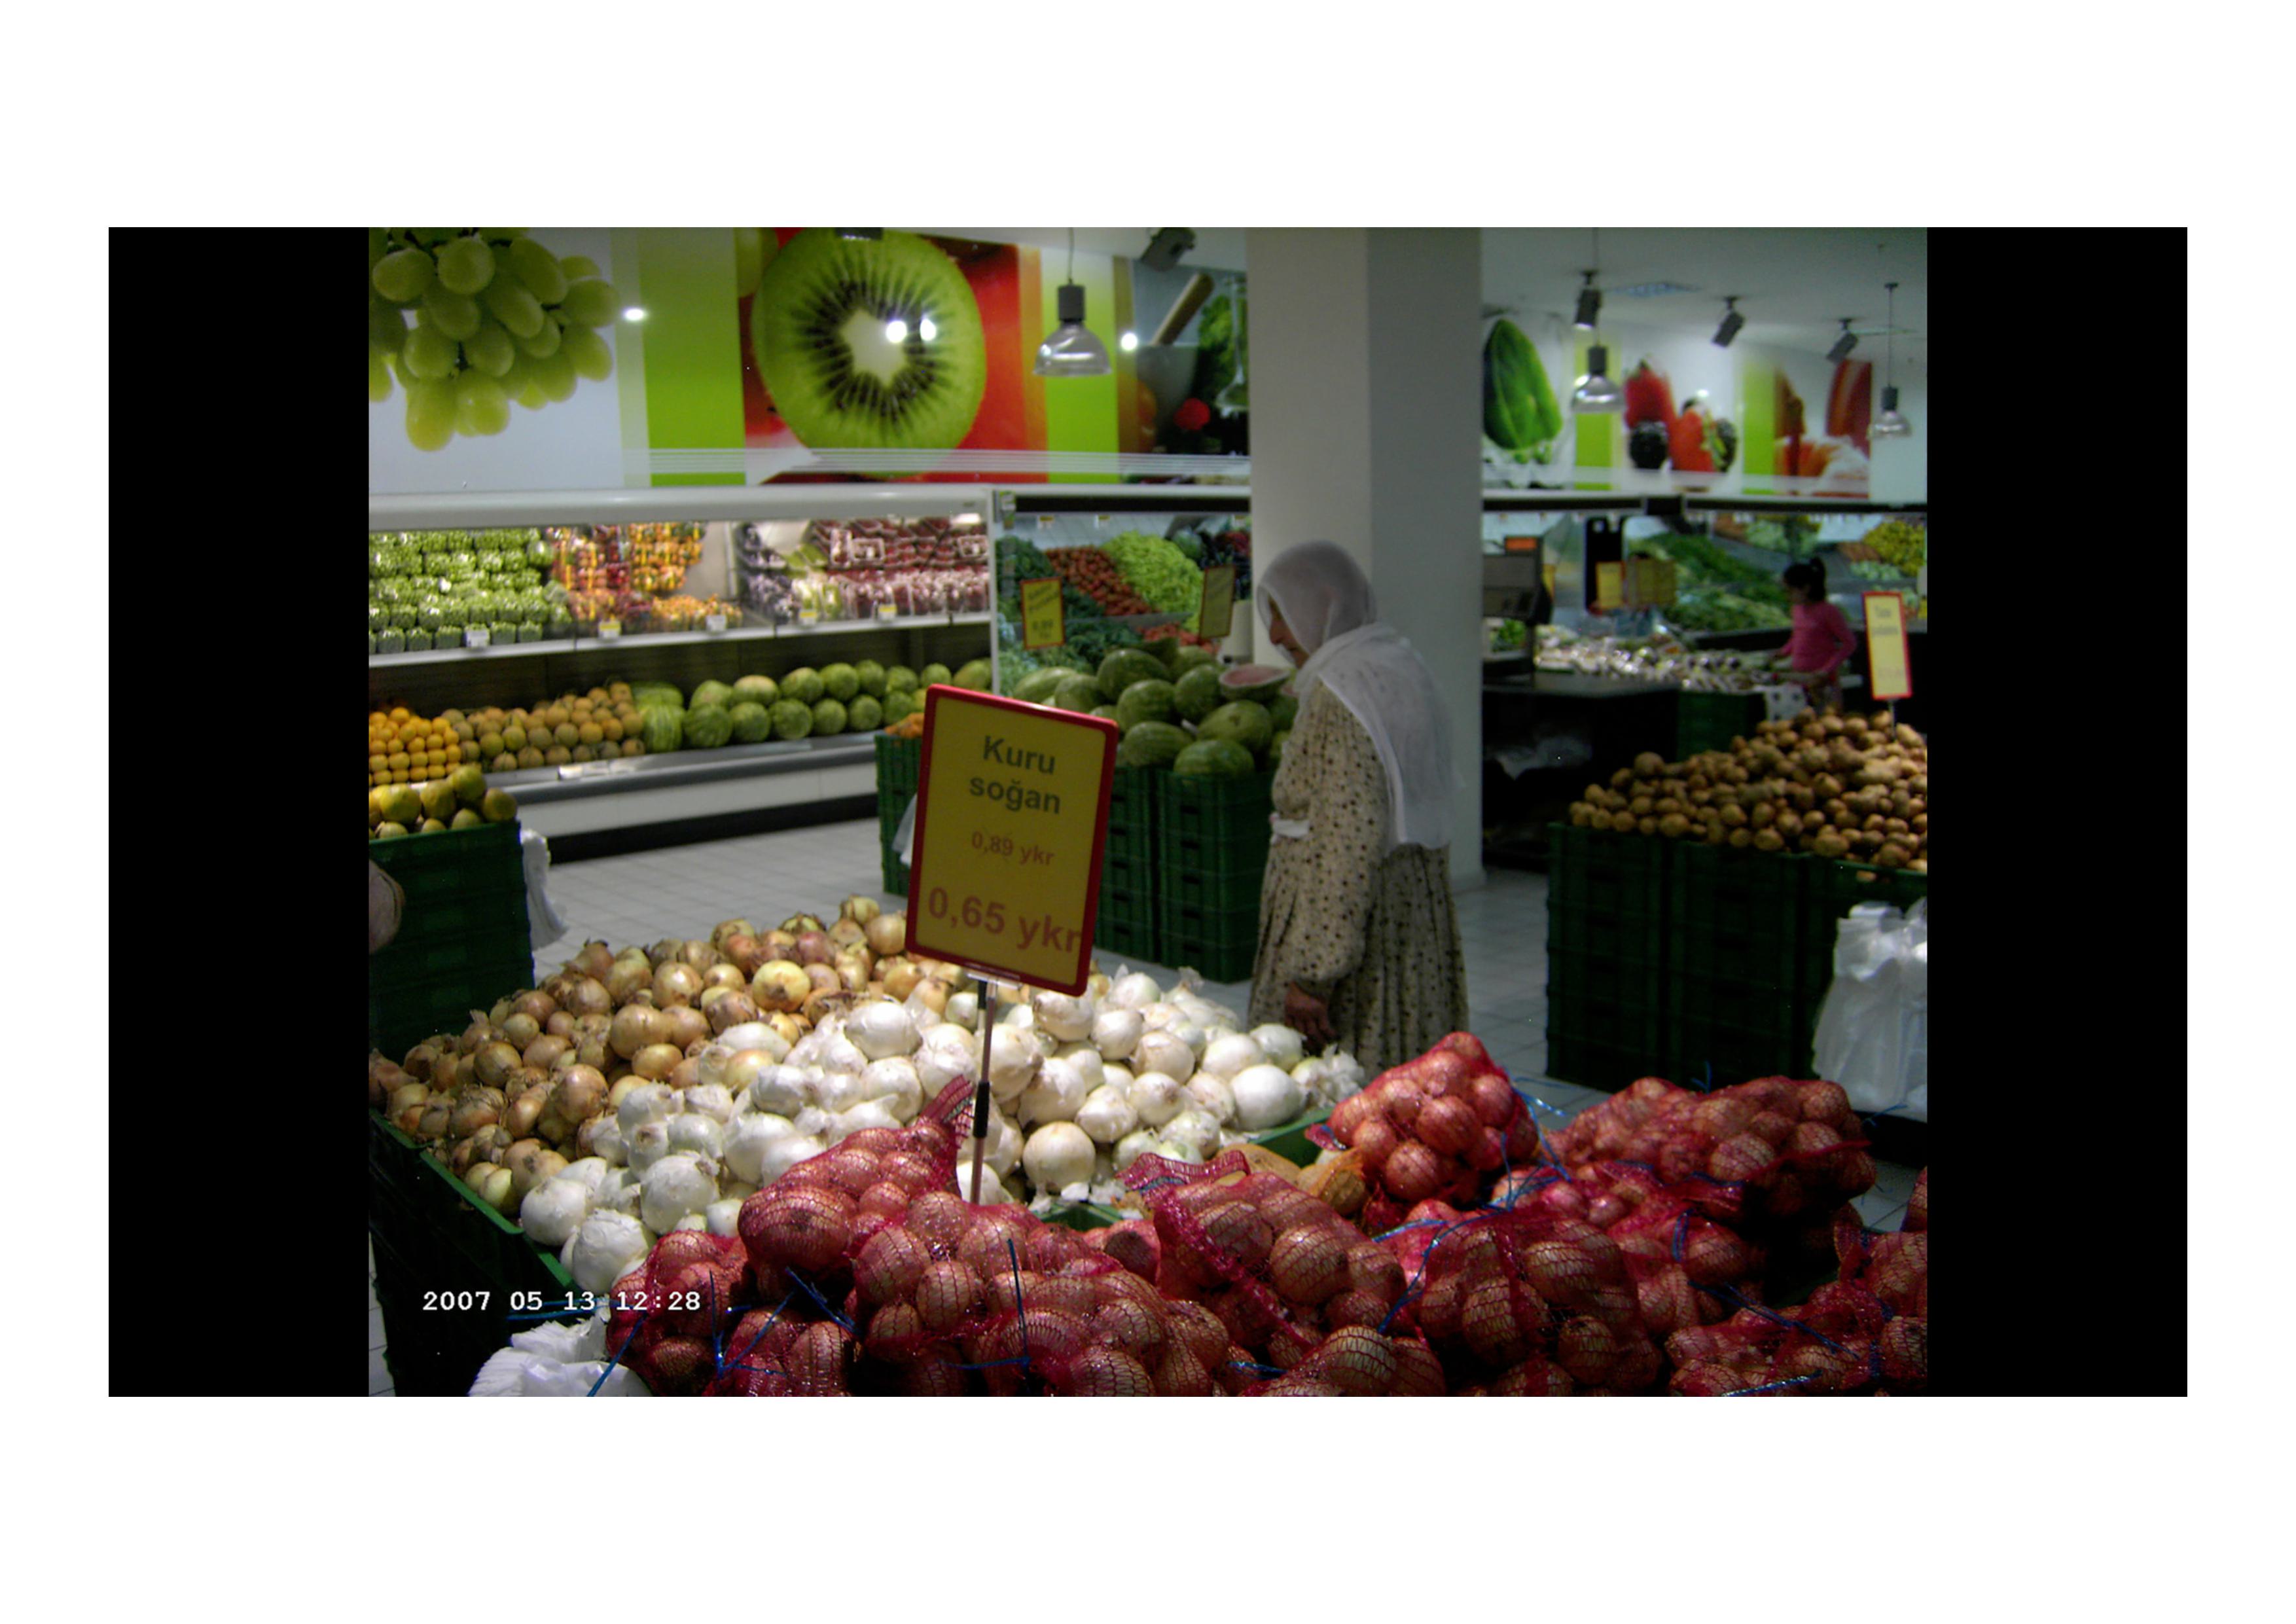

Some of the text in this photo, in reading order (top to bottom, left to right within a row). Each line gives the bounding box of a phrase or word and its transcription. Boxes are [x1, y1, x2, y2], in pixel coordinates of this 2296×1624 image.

[983, 735, 1056, 774] Kuru
[969, 776, 1061, 814] soğan
[971, 831, 1054, 866] 0,89 ykr
[929, 887, 1083, 953] 0,65 ykr
